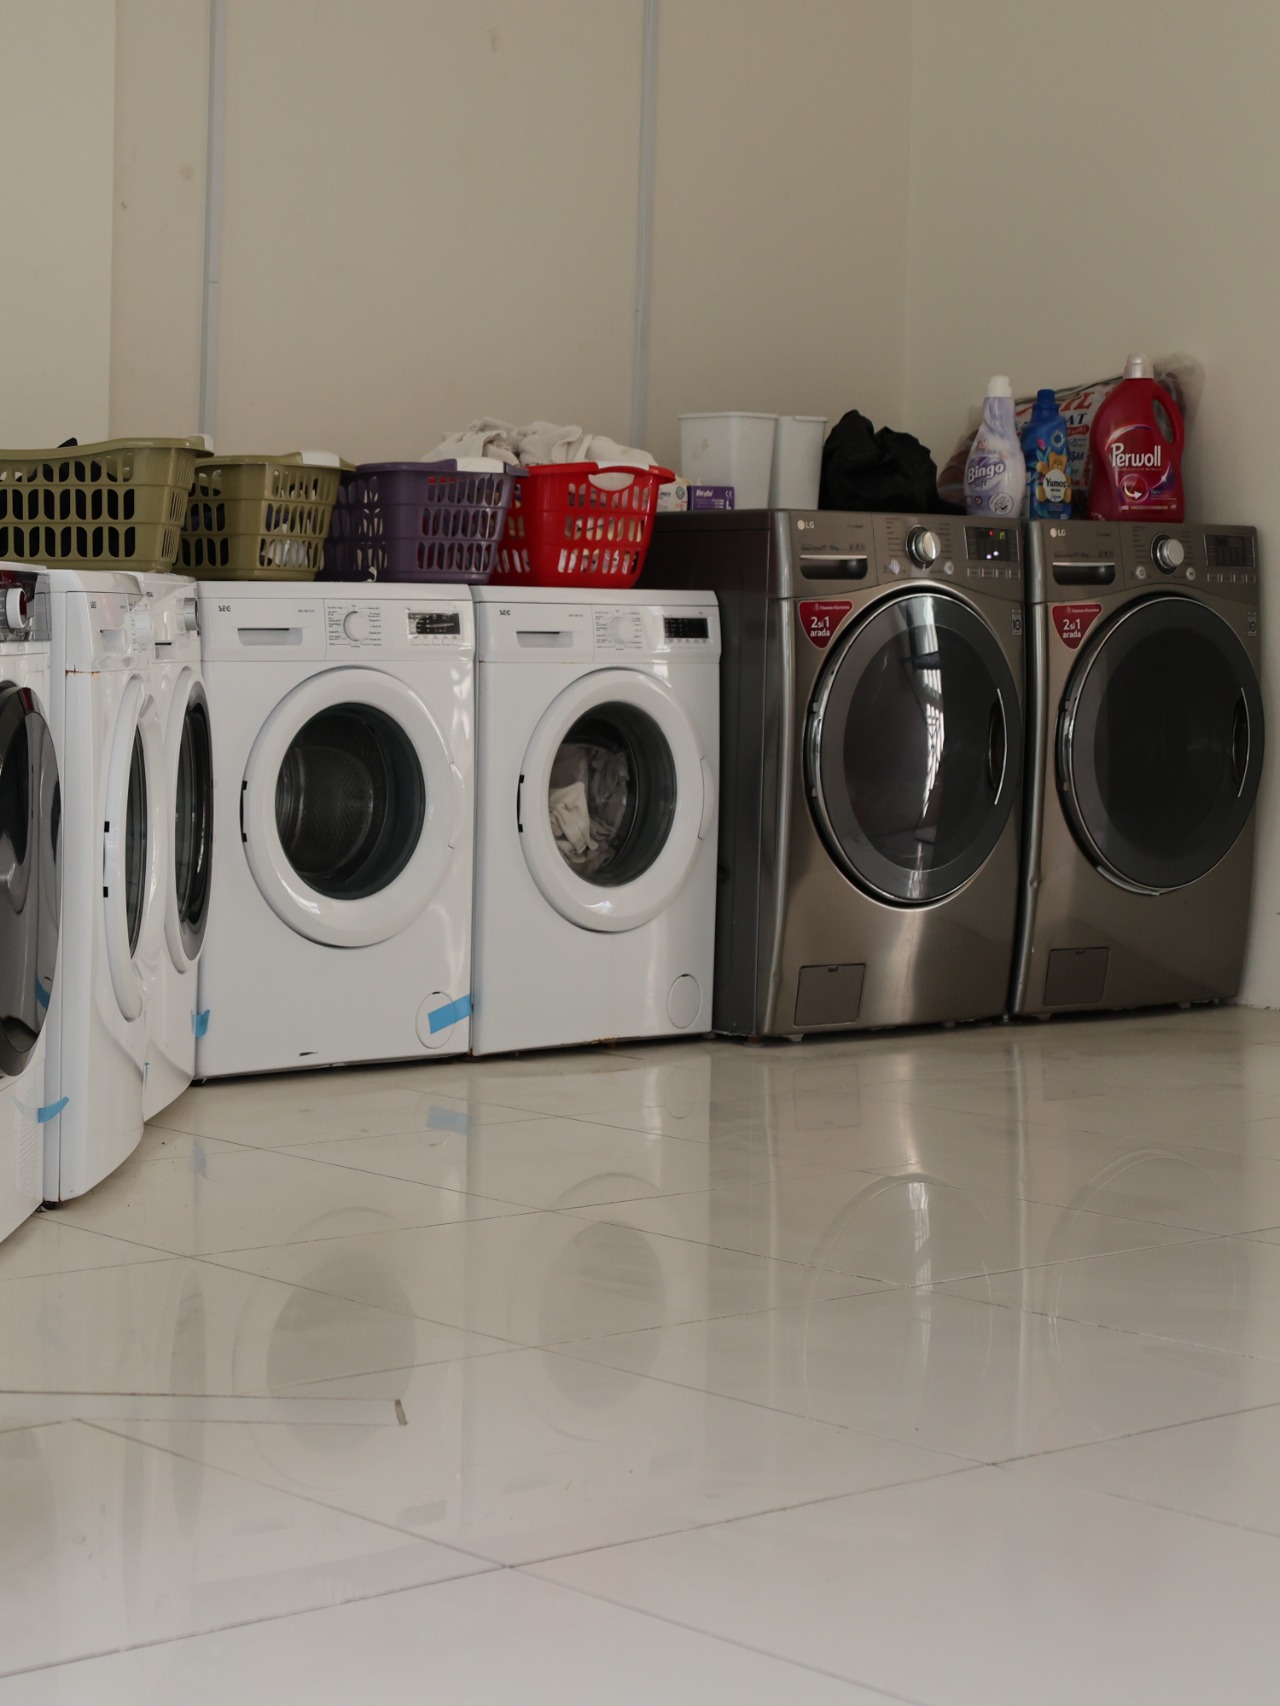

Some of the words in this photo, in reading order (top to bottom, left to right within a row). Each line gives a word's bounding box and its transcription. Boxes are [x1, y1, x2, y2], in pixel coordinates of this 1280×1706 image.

[1111, 443, 1161, 467] Perwoll
[967, 462, 1006, 483] Bingo
[1046, 477, 1067, 488] Yumos
[805, 521, 815, 529] LG
[810, 628, 830, 637] arada
